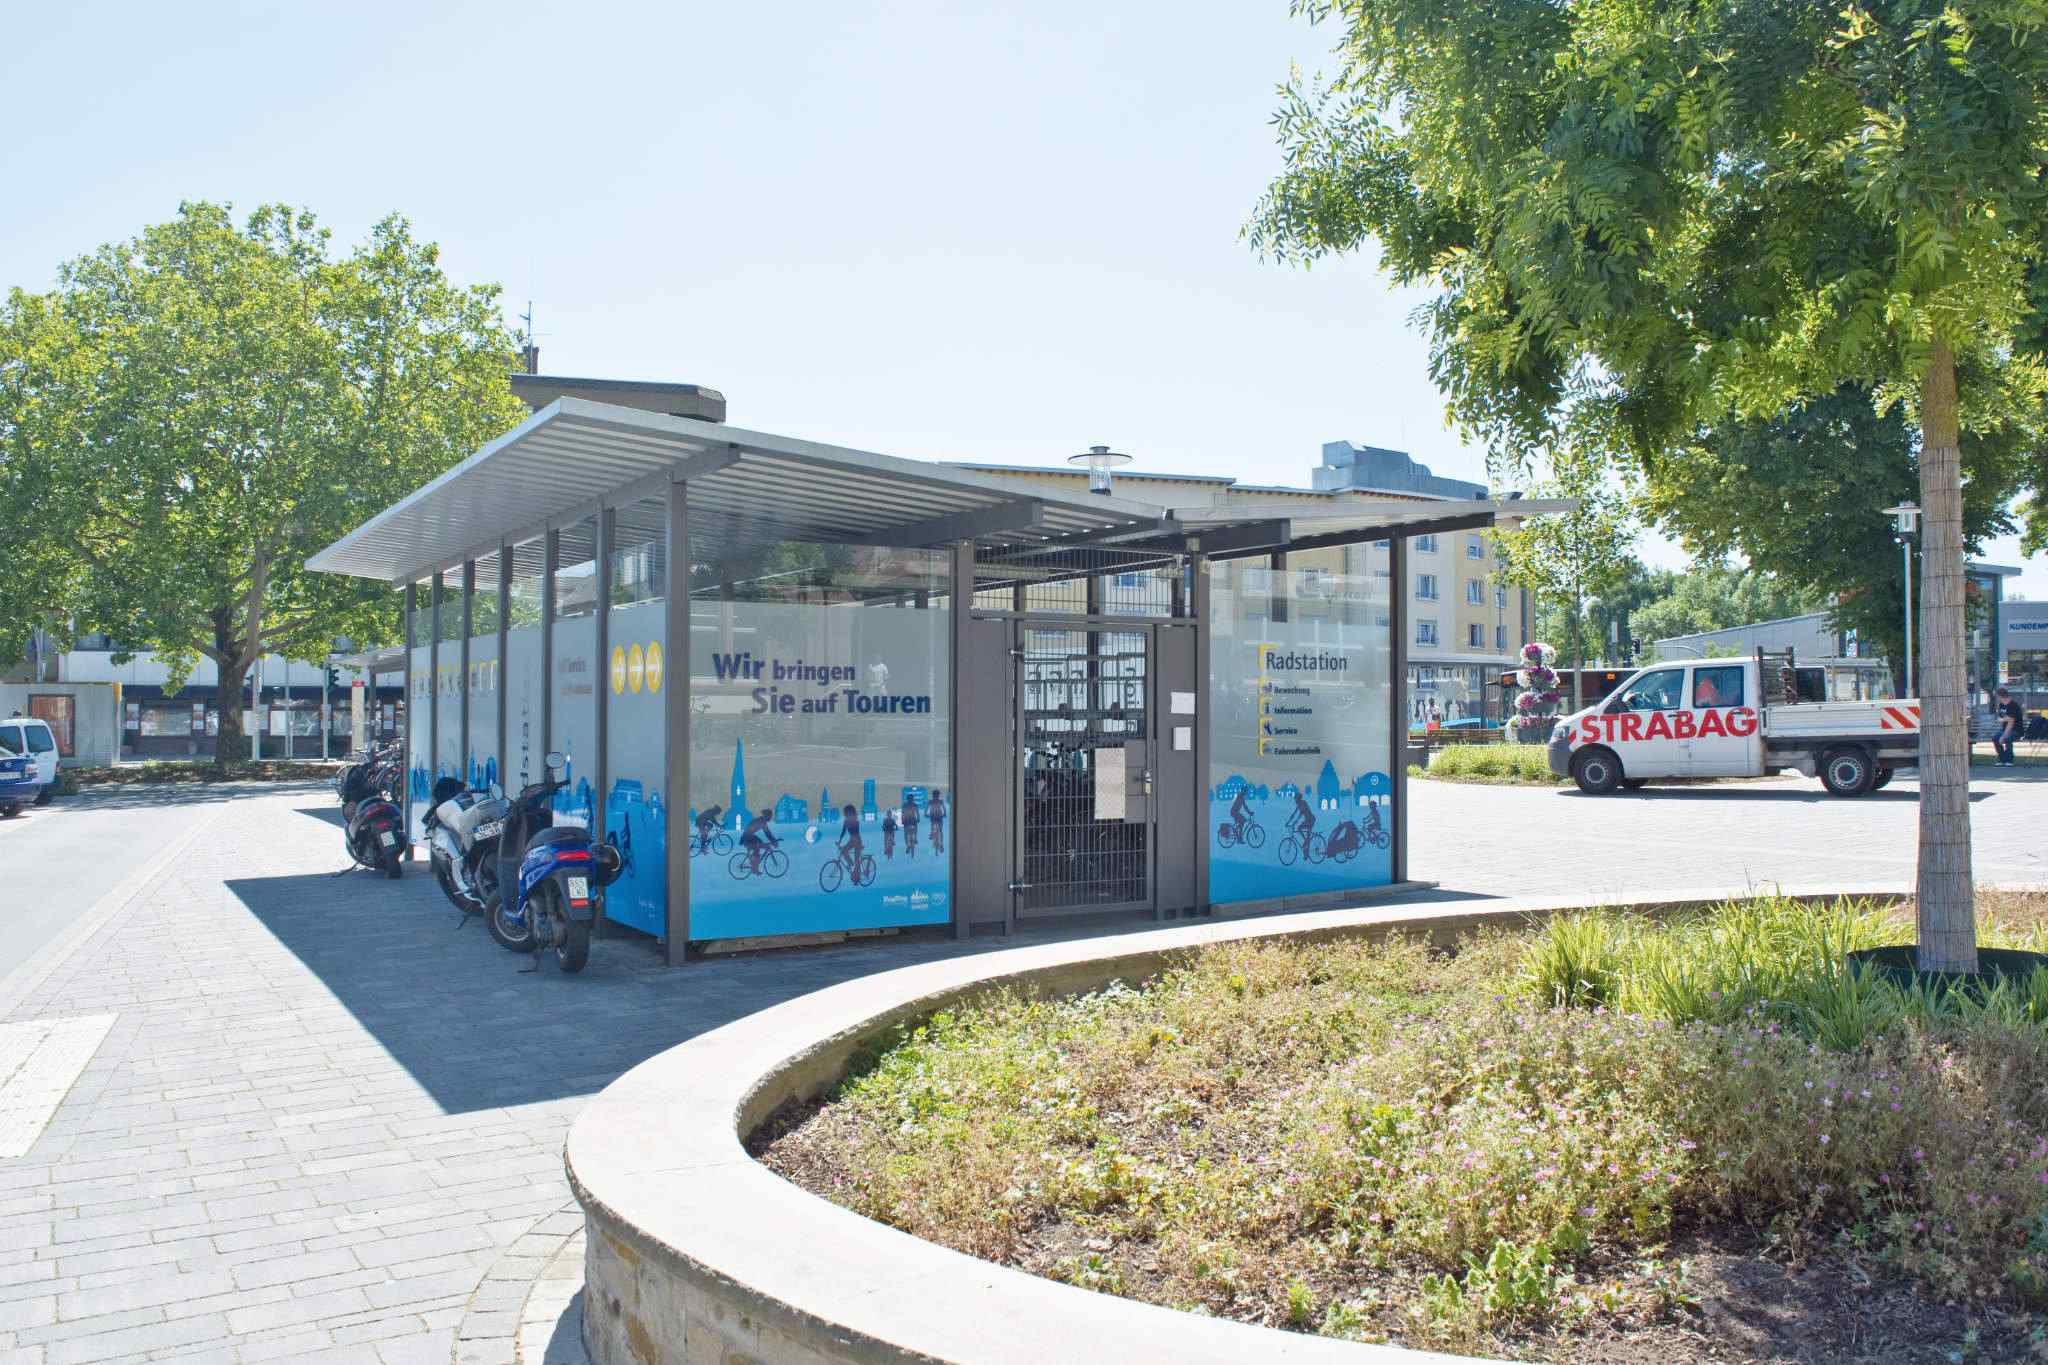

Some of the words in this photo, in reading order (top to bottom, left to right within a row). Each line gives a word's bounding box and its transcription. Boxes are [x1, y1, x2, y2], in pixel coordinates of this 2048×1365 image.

[712, 652, 765, 680] Wir
[773, 659, 856, 686] bringen
[1266, 651, 1348, 671] Radstation
[751, 687, 796, 714] Sie
[802, 693, 838, 713] auf
[843, 689, 931, 714] Touren
[1274, 704, 1312, 714] Information
[1274, 726, 1298, 735] Service
[1581, 706, 1757, 744] STRABAG
